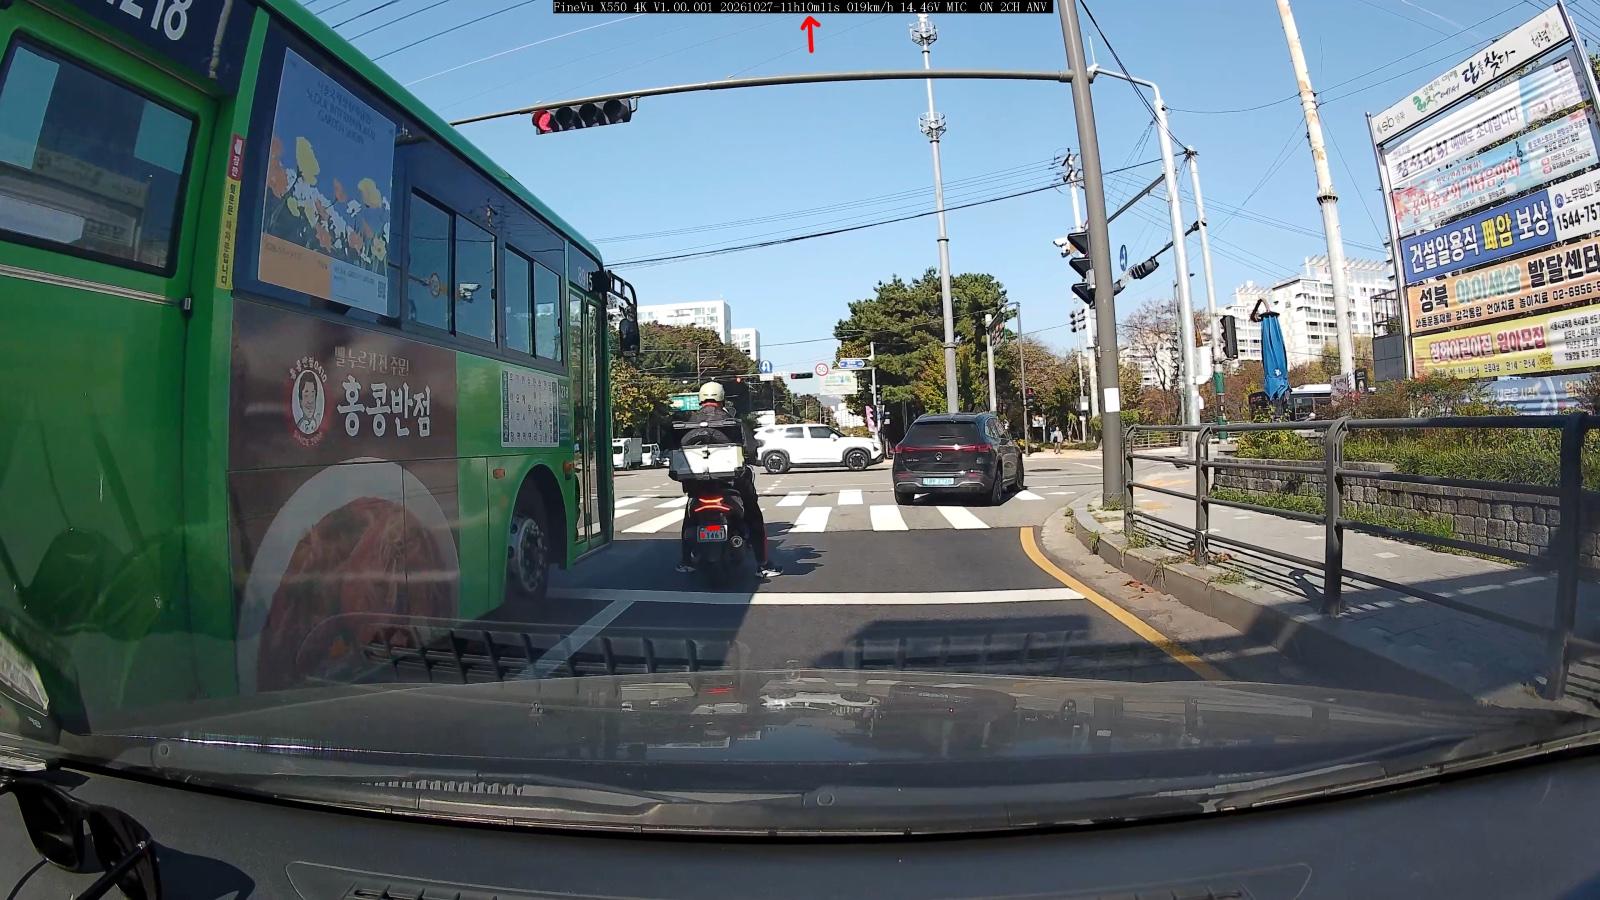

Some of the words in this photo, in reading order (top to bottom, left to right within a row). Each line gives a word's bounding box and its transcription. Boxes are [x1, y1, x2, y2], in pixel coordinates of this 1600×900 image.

[1564, 183, 1593, 204] 노무법인
[1409, 225, 1480, 273] 건설일용직
[1517, 201, 1550, 240] 보상
[1419, 283, 1449, 314] 성북
[1528, 246, 1600, 288] 발달센터
[1486, 298, 1516, 315] 언어치료
[336, 375, 432, 438] 홍콩반점
